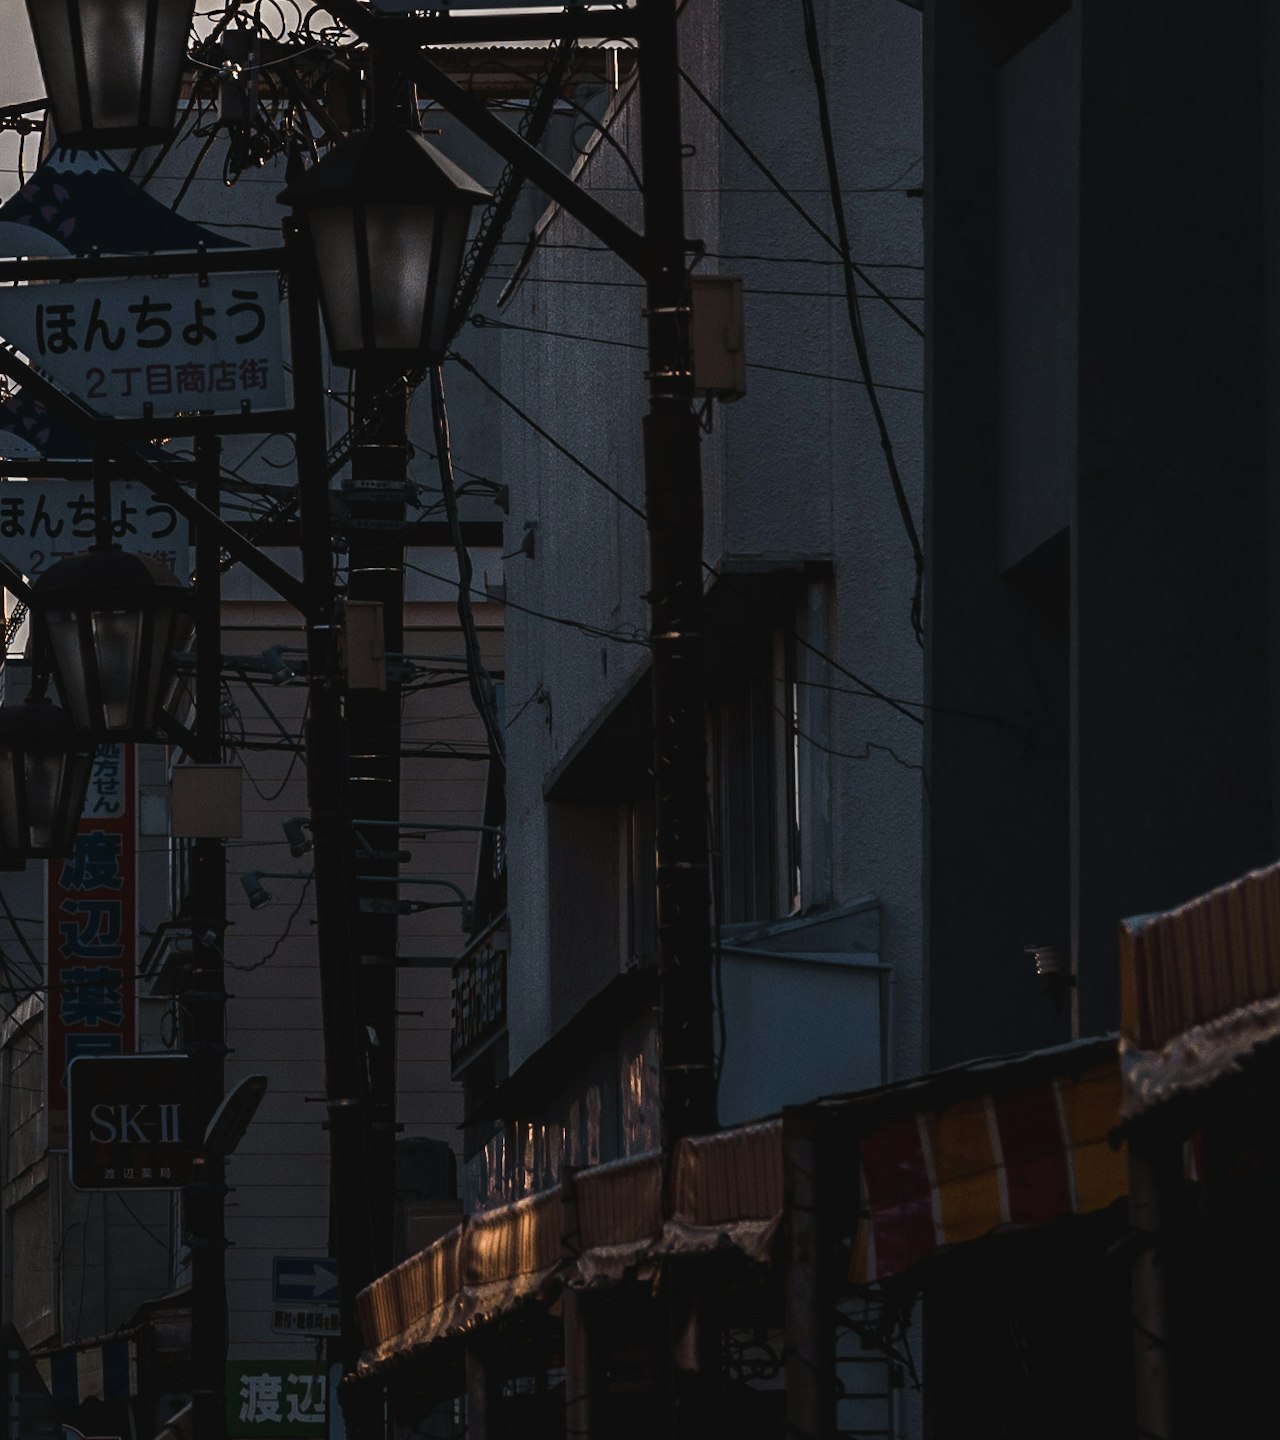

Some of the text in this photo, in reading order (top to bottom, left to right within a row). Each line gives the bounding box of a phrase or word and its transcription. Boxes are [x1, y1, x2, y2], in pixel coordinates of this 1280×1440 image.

[36, 288, 269, 356] ほんちょう
[85, 359, 269, 400] 2丁目商店街
